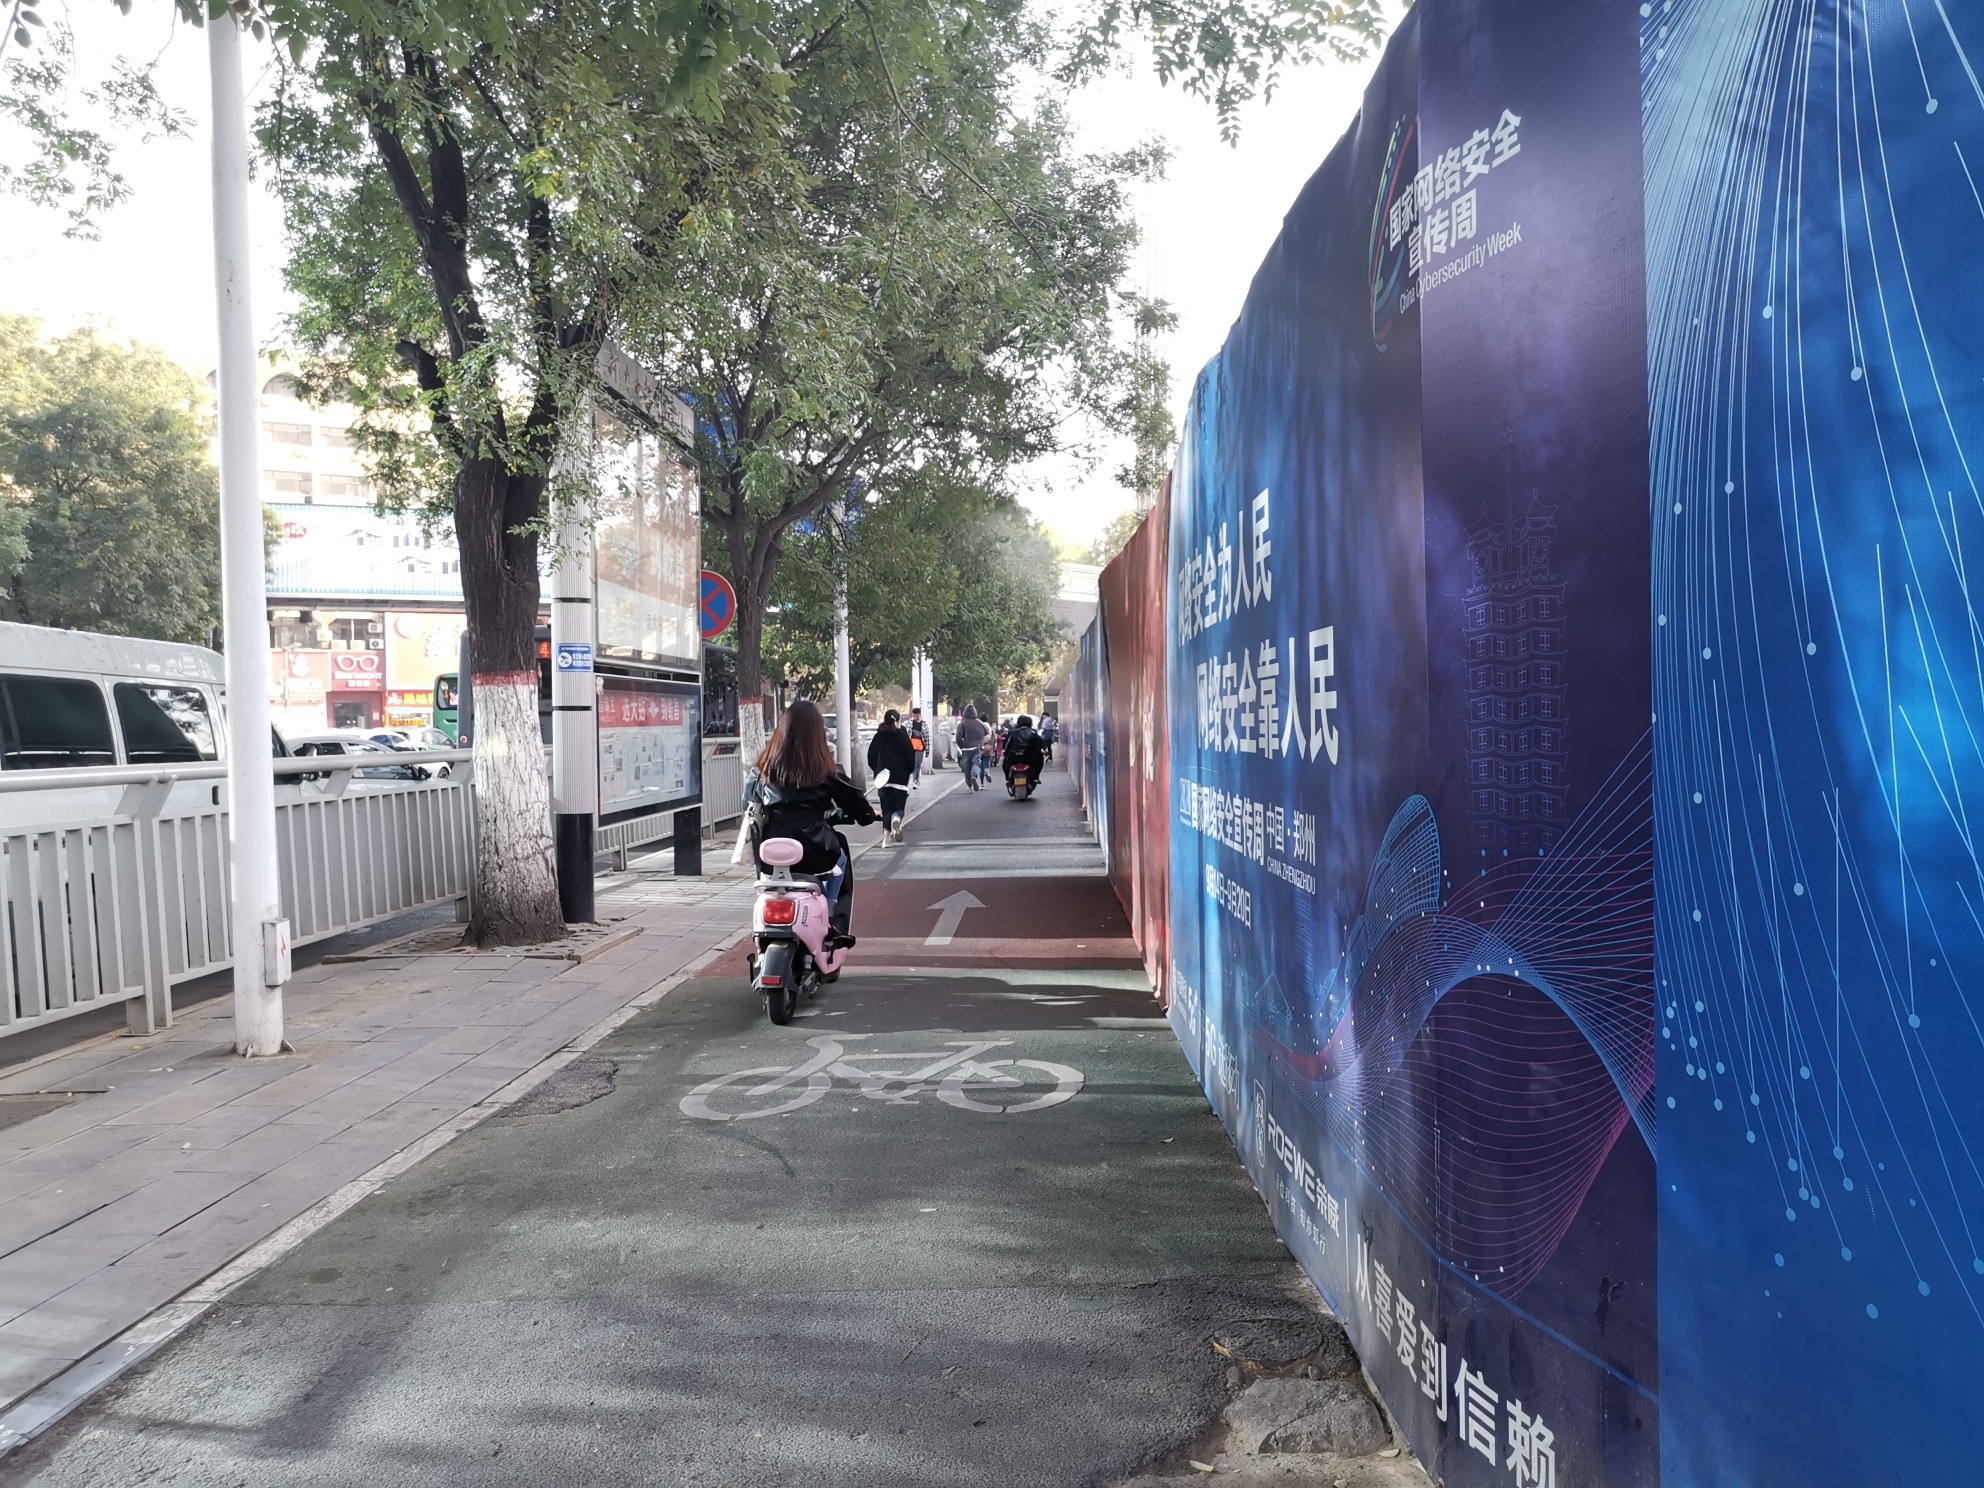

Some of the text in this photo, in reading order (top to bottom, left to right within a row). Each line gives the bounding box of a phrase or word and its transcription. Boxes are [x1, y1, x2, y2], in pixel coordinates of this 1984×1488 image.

[1390, 109, 1521, 252] 国家网络安全
[1408, 188, 1477, 277] 宣传周
[1400, 222, 1522, 315] China Cybersecurity Week
[1197, 625, 1338, 766] 网络安全靠人民
[1268, 1112, 1340, 1238] ROEWE 荣威
[1356, 1234, 1556, 1488] 从喜爱到信赖
